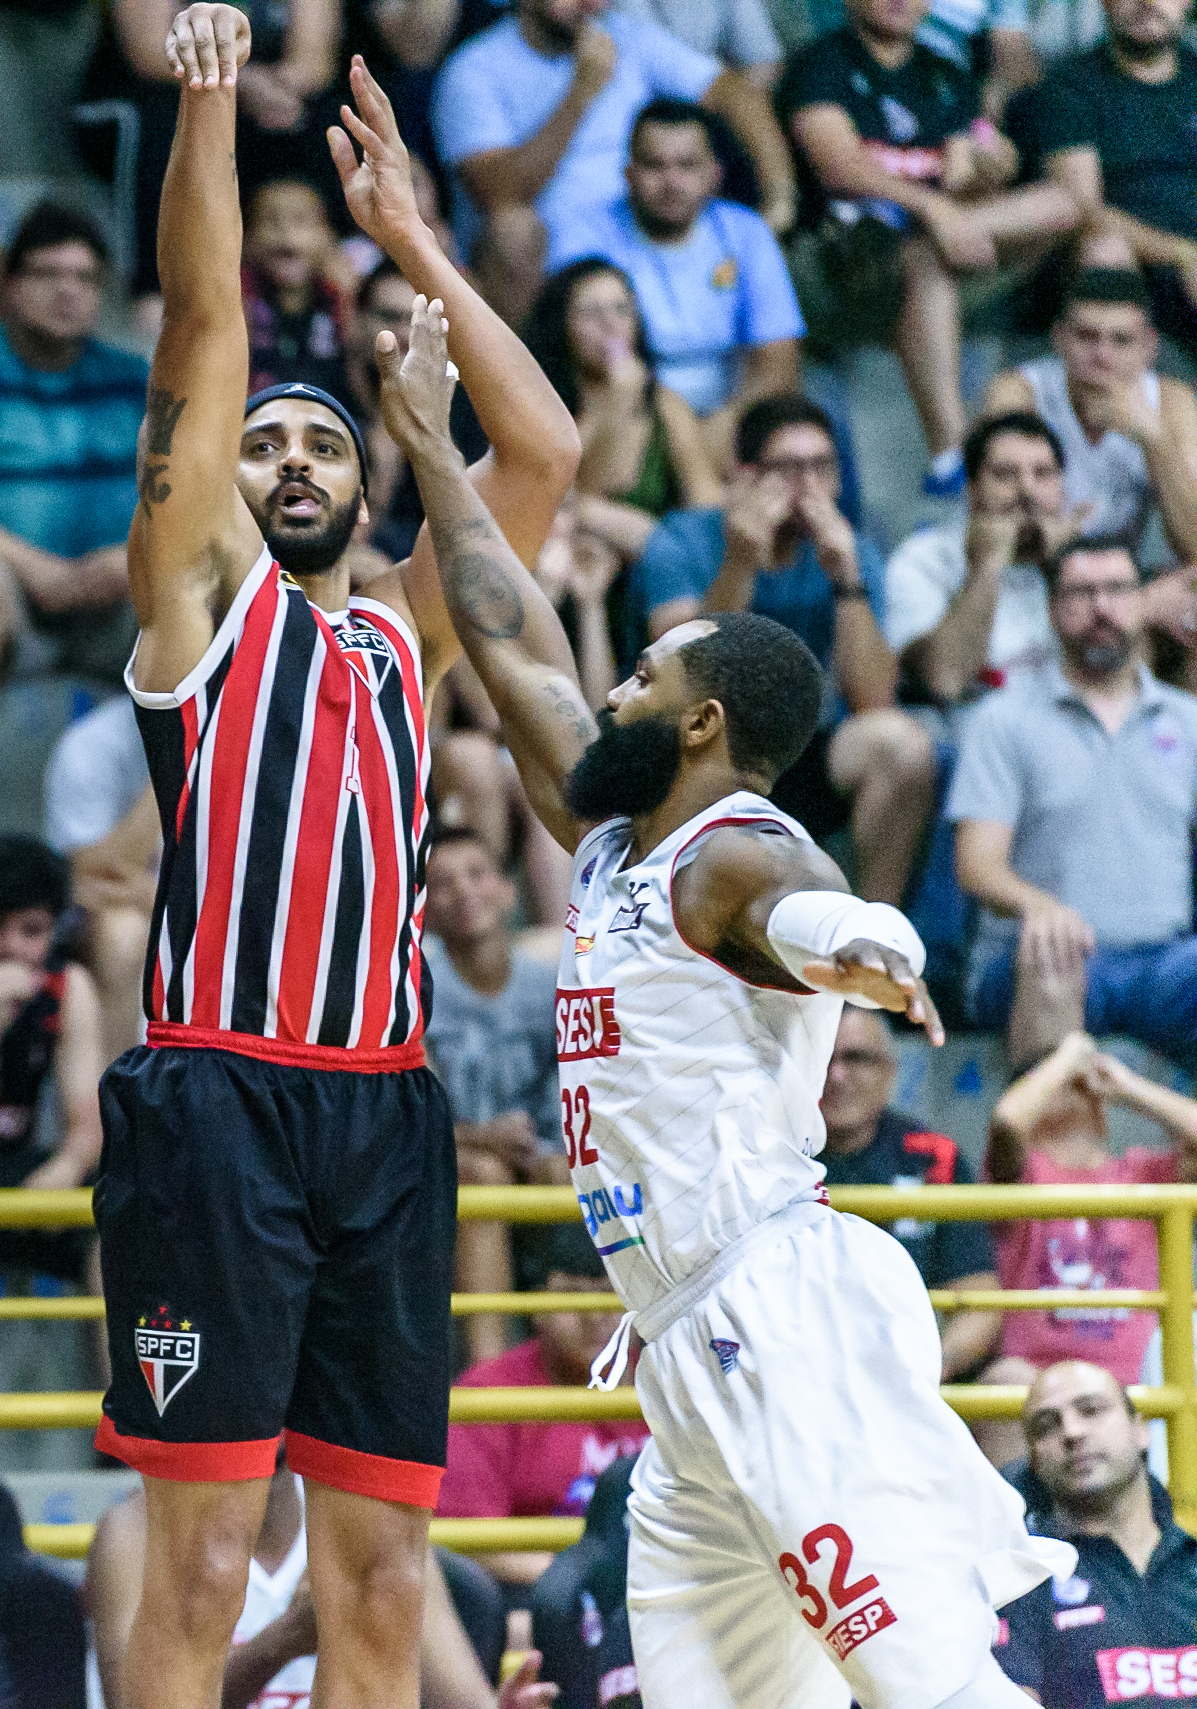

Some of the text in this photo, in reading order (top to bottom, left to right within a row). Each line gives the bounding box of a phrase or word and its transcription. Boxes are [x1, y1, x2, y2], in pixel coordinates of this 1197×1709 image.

[335, 632, 387, 651] SPFC
[561, 1085, 600, 1170] 32
[137, 1335, 193, 1359] SPFC
[779, 1523, 880, 1630] 32
